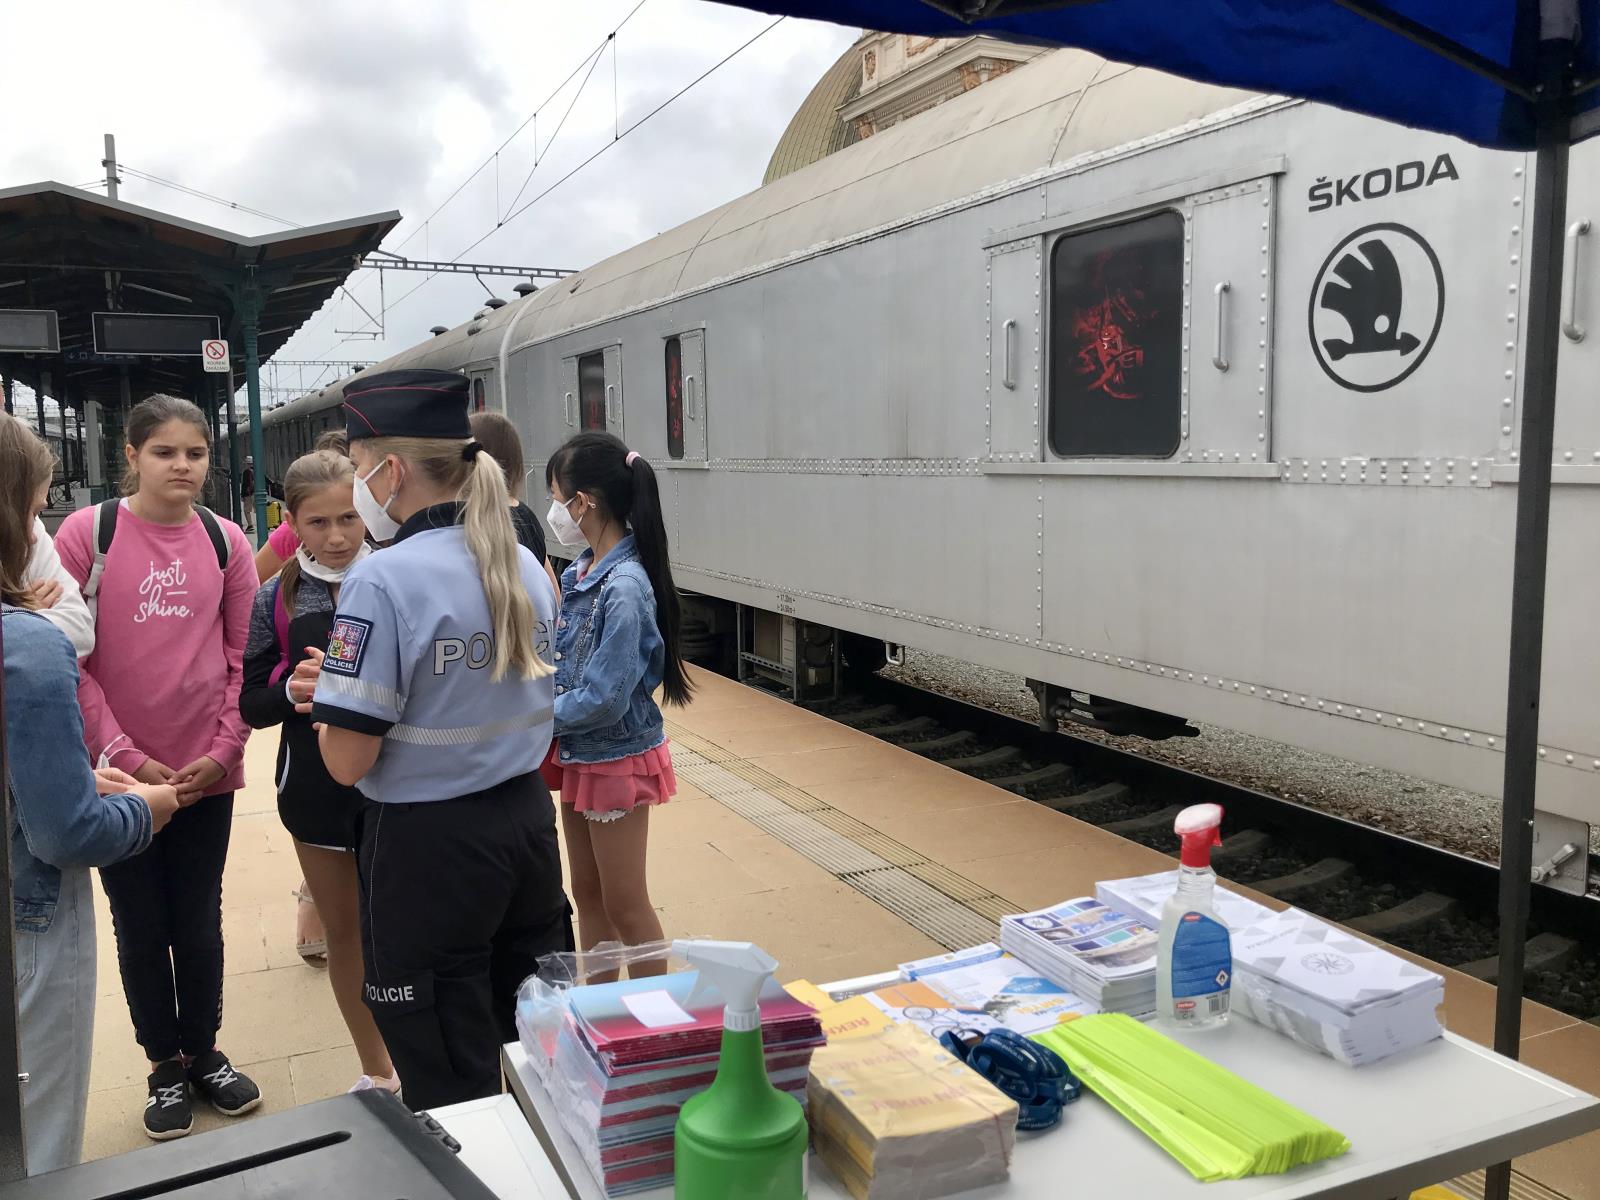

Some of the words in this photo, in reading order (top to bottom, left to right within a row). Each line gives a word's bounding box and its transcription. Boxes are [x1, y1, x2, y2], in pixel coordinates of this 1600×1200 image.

[1308, 153, 1460, 213] ŠKODA
[139, 558, 187, 595] just
[133, 584, 194, 623] shine.
[326, 658, 355, 669] POLICIE
